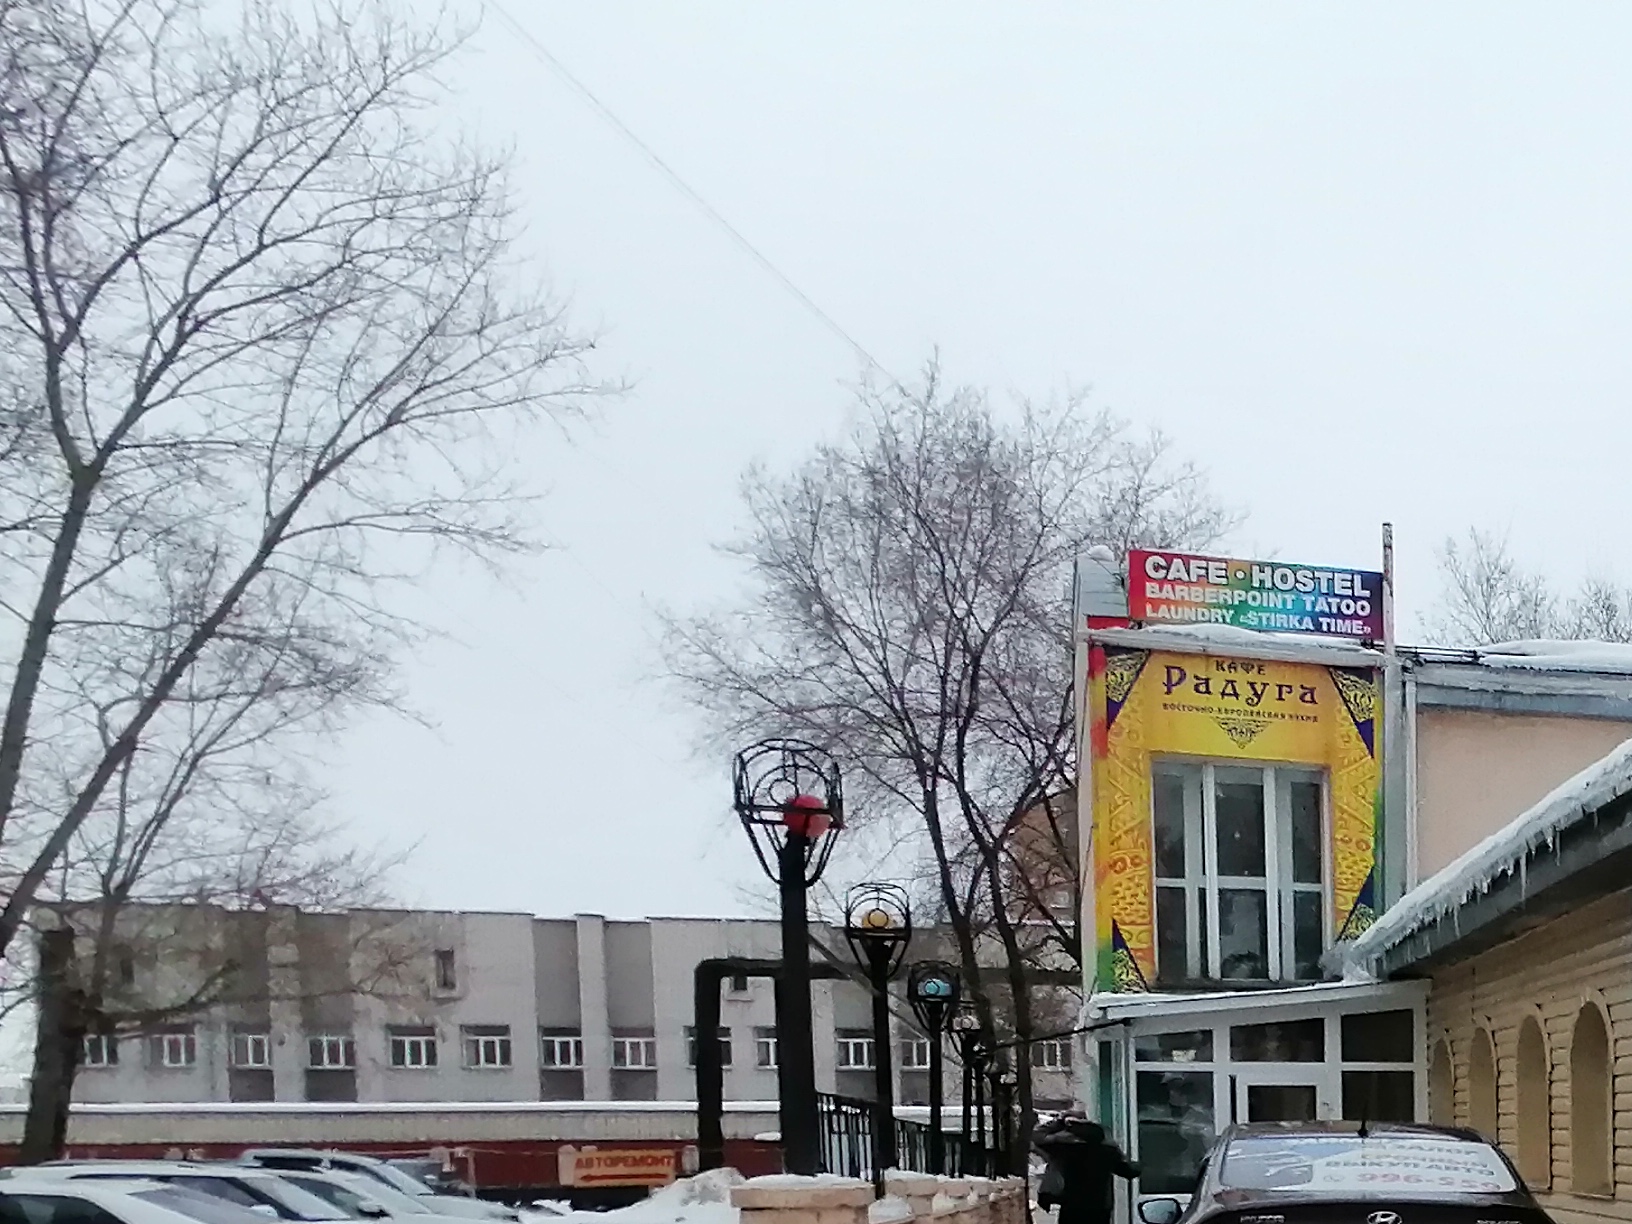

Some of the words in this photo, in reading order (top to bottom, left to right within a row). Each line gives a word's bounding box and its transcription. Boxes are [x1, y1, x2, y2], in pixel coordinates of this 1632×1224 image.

[1144, 555, 1229, 585] CAFE
[1251, 564, 1371, 598] HOSTEL
[1145, 581, 1296, 610] BARBERPOINT
[1304, 597, 1371, 617] TATOO
[1145, 602, 1235, 624] LAUNDRY
[1162, 664, 1319, 707] Радуга
